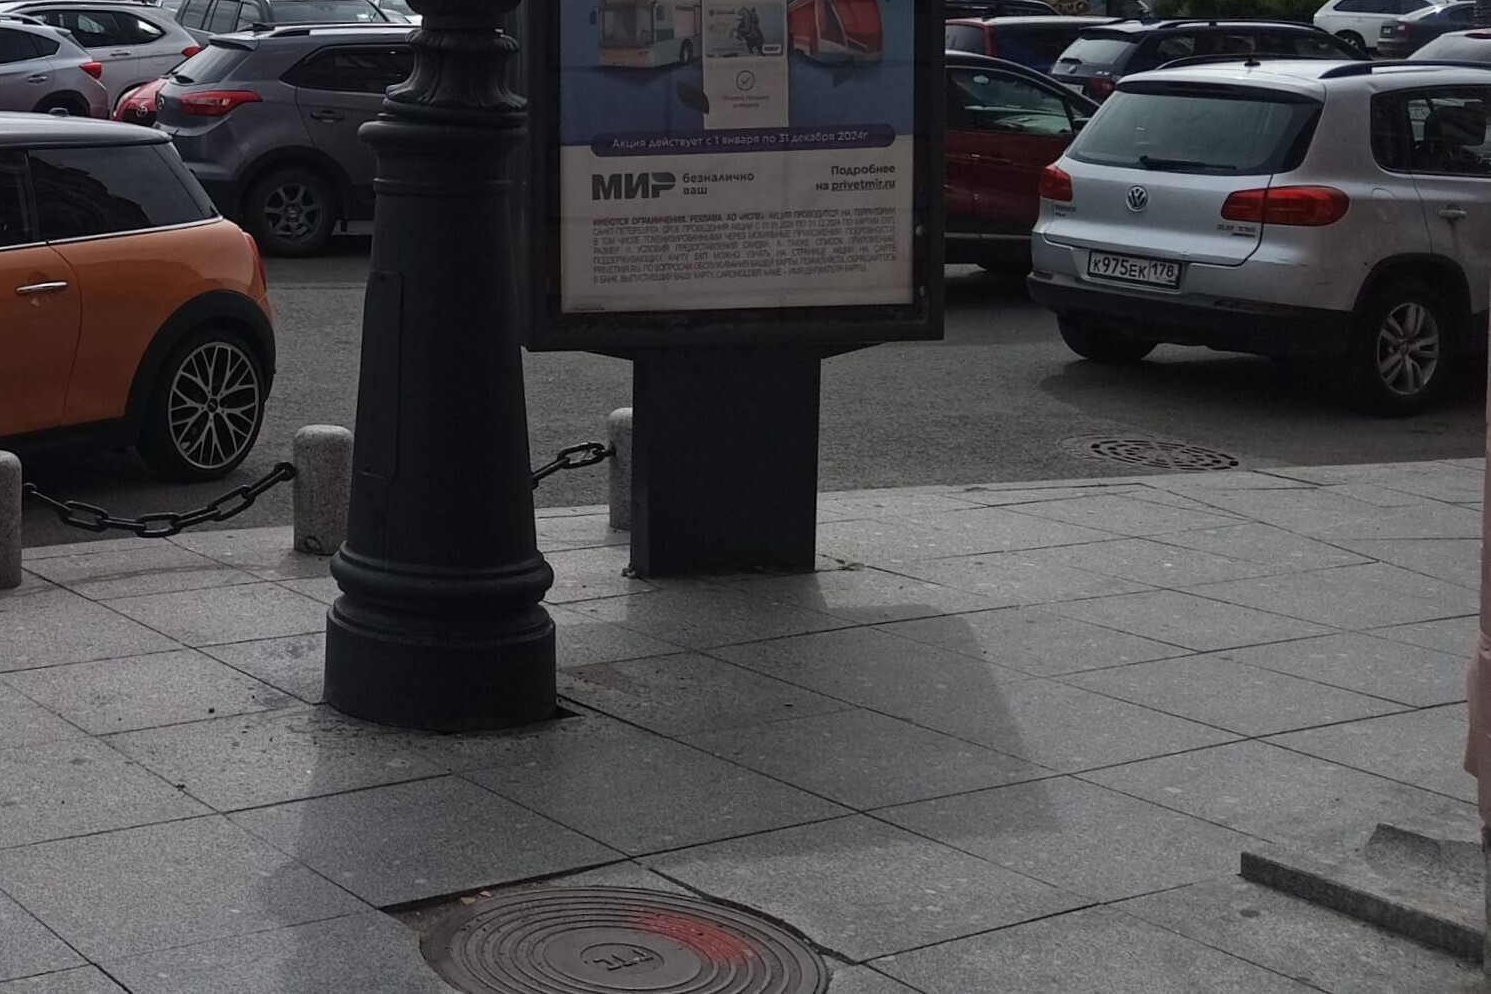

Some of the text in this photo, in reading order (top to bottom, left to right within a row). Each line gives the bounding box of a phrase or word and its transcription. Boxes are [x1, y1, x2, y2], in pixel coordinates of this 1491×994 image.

[612, 138, 646, 150] Акция
[648, 136, 703, 148] действует
[715, 136, 719, 145] 1
[722, 134, 759, 146] января
[762, 135, 776, 144] по
[779, 133, 789, 143] 31
[791, 132, 835, 144] декабря
[838, 130, 870, 141] 2024г.
[682, 170, 754, 183] безналично
[831, 164, 896, 177] Подробнее
[591, 171, 676, 200] МИР
[683, 185, 707, 195] ваш
[816, 178, 896, 192] на privetmir.ru
[1093, 257, 1175, 279] К975ЕК 178
